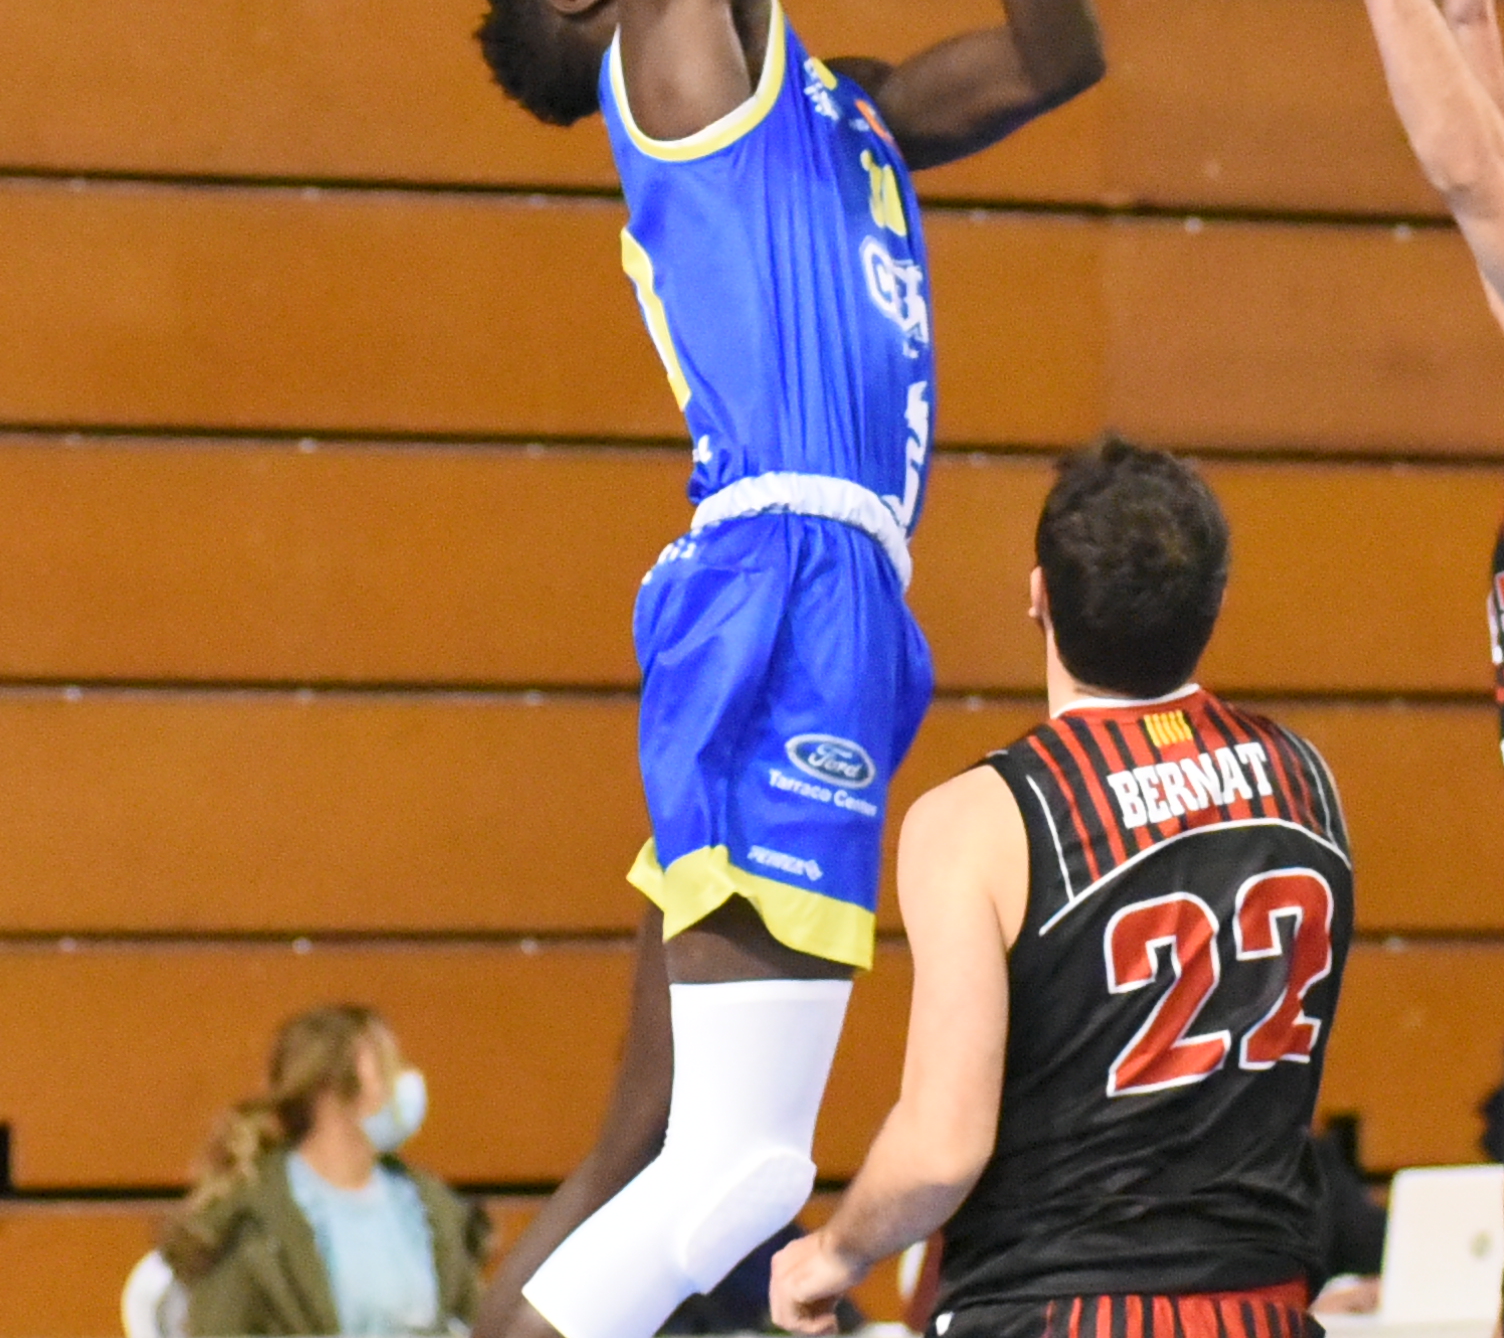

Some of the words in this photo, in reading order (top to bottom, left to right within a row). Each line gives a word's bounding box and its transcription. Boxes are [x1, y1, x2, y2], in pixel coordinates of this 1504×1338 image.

[807, 743, 865, 778] Ford
[1107, 742, 1273, 829] BERNAT
[1104, 866, 1335, 1097] 22
